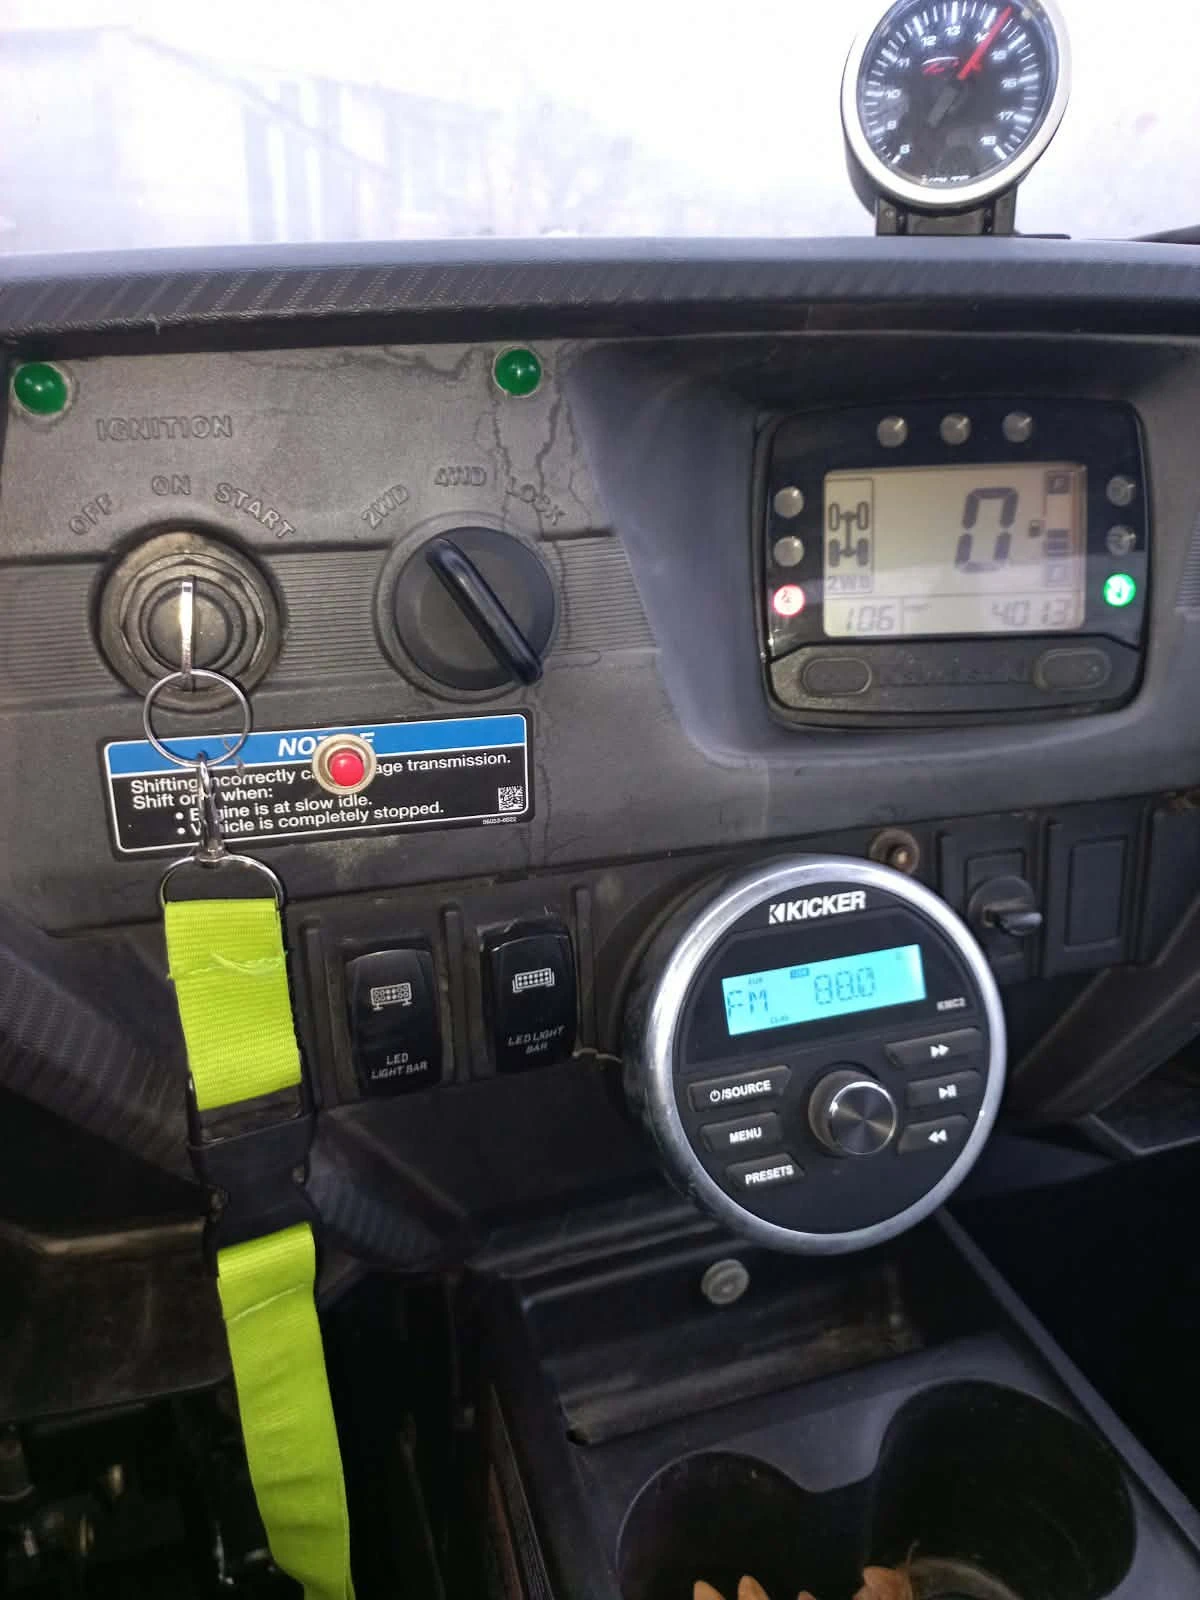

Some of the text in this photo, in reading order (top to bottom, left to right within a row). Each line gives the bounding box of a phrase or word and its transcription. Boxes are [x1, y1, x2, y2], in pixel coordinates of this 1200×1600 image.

[920, 35, 937, 47] 12
[944, 25, 961, 37] 13
[897, 57, 910, 68] 11
[885, 88, 901, 99] 10
[998, 111, 1015, 121] 17
[96, 415, 233, 442] IGNITION
[151, 474, 191, 496] ON
[434, 466, 488, 488] 4WD
[68, 492, 113, 536] OFF
[214, 482, 296, 540] START
[361, 483, 410, 530] 2WD
[846, 604, 896, 632] 106
[131, 778, 198, 796] Shifting
[211, 769, 296, 787] ncorrectly
[407, 751, 511, 772] transmission.
[133, 793, 175, 810] Shift
[221, 786, 273, 802] when:
[190, 793, 372, 822] Egine is at slow idle.
[259, 817, 274, 831] is
[278, 810, 369, 829] completely
[374, 802, 444, 821] stopped.
[786, 890, 866, 921] KICKER
[727, 988, 769, 1017] FM
[371, 1060, 428, 1080] LIGHT BAR
[386, 1052, 409, 1066] LED
[729, 1126, 763, 1144] MENU
[744, 1164, 795, 1186] PRESETS
